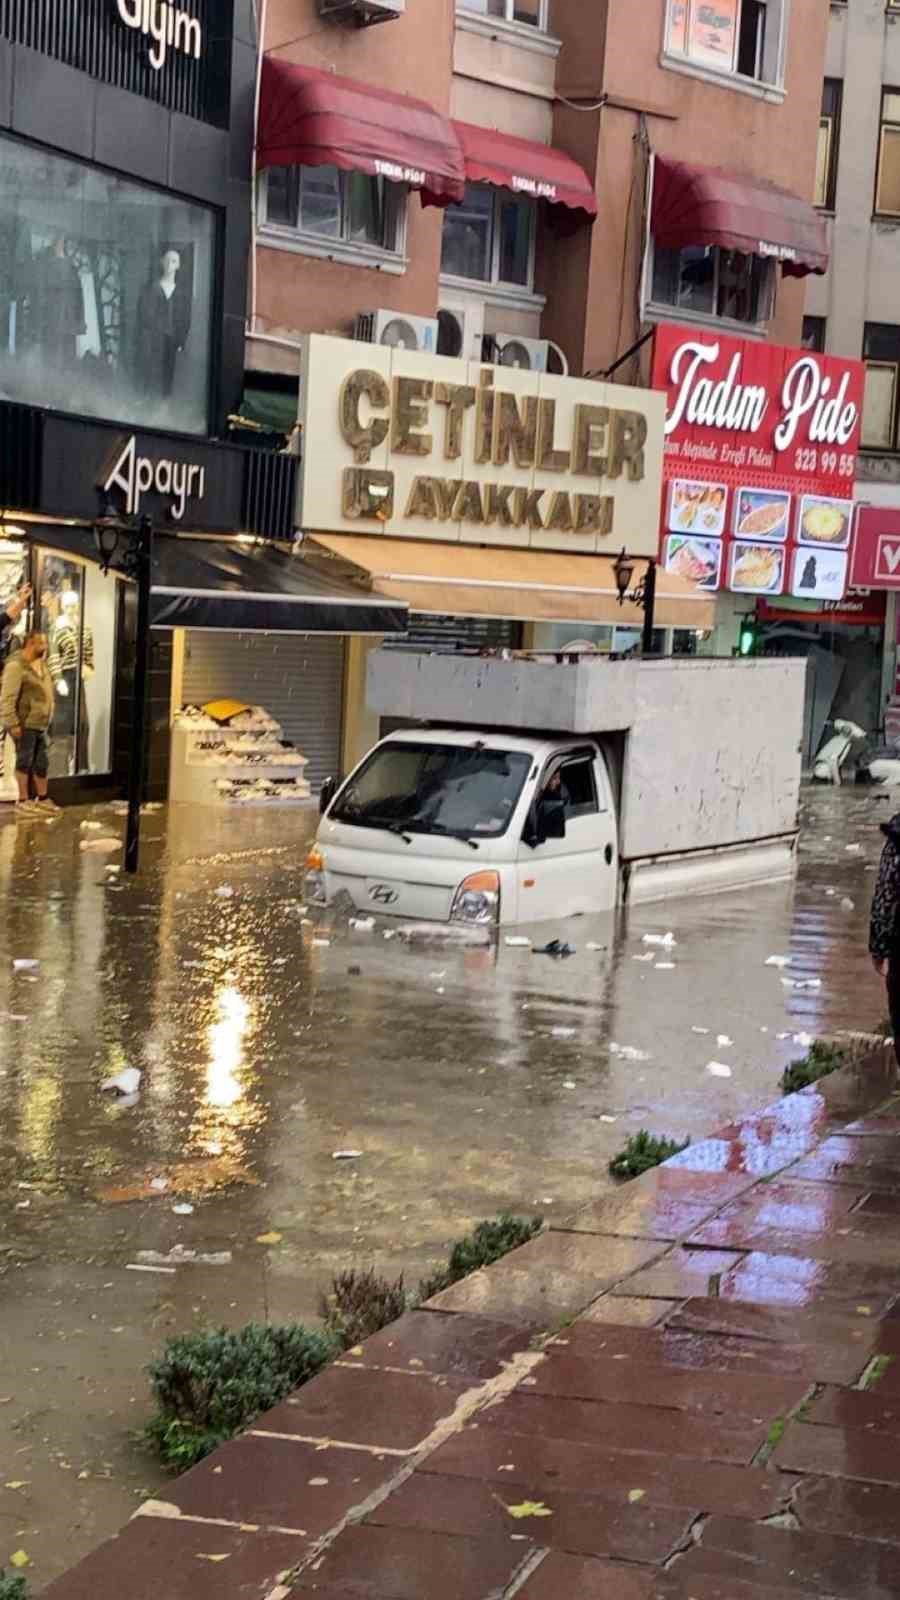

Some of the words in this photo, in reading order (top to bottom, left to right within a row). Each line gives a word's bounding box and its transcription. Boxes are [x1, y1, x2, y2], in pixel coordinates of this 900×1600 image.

[339, 367, 648, 482] ÇETİNLER
[664, 341, 768, 435] Tadım
[774, 356, 858, 451] Pide
[794, 447, 817, 472] 323
[821, 451, 836, 474] 99
[838, 453, 855, 477] 55
[403, 475, 615, 536] AYAKKABI
